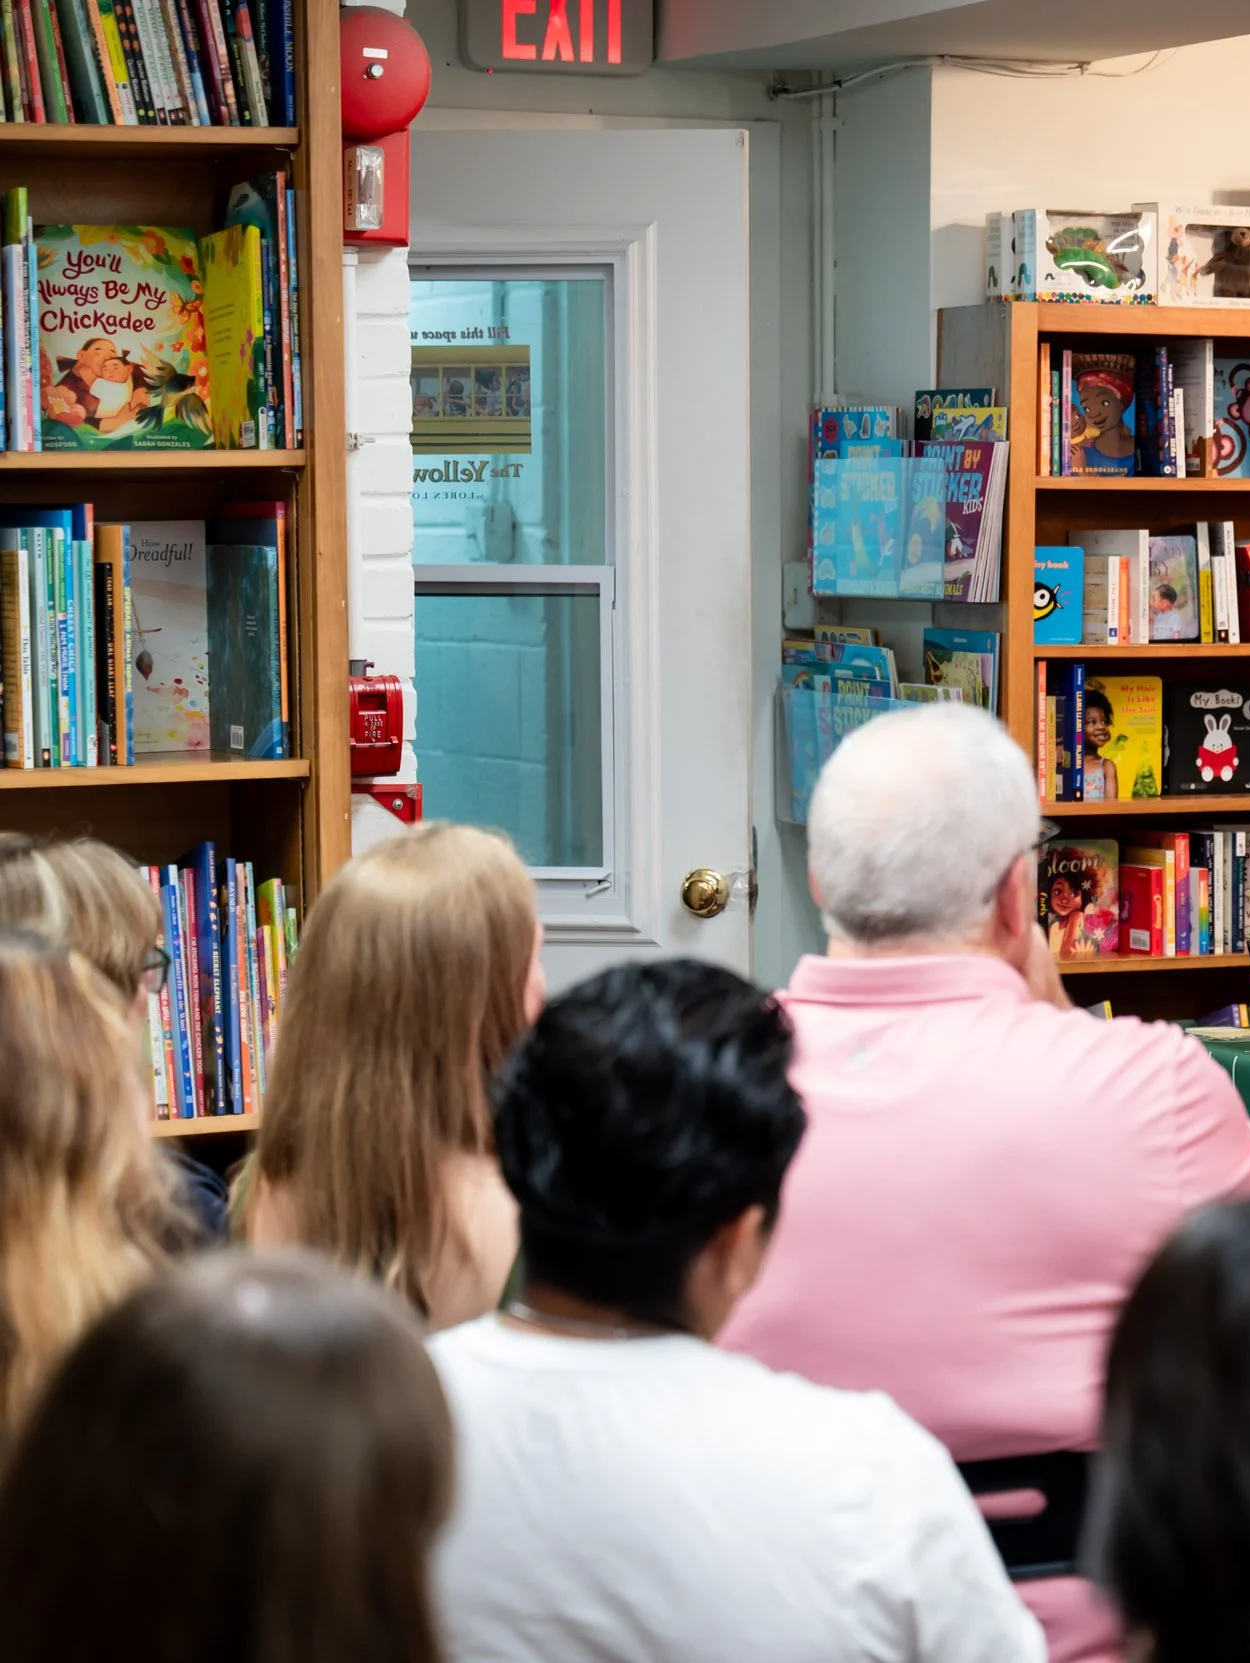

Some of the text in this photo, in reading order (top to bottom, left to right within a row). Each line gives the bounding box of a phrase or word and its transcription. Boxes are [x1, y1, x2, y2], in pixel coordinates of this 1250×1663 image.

[284, 41, 294, 73] MOON
[62, 250, 123, 280] You'll
[38, 279, 168, 310] Always Be My
[40, 308, 155, 335] Chickadee
[963, 449, 982, 470] BY
[911, 472, 983, 503] STICKER
[962, 498, 984, 515] KIDS
[130, 542, 193, 567] Dreadful!
[141, 538, 160, 548] How
[67, 641, 76, 674] CHICK
[1120, 685, 1156, 694] My Hair
[1138, 695, 1156, 703] Like
[1194, 695, 1210, 706] My
[364, 714, 382, 722] PULL
[364, 730, 382, 739] FIRE
[1047, 851, 1100, 878] loom
[228, 881, 236, 913] RAYNER
[192, 947, 200, 974] STICKING
[212, 951, 221, 1014] SECRET ELEPHANT
[195, 1033, 203, 1059] CHICKEN
